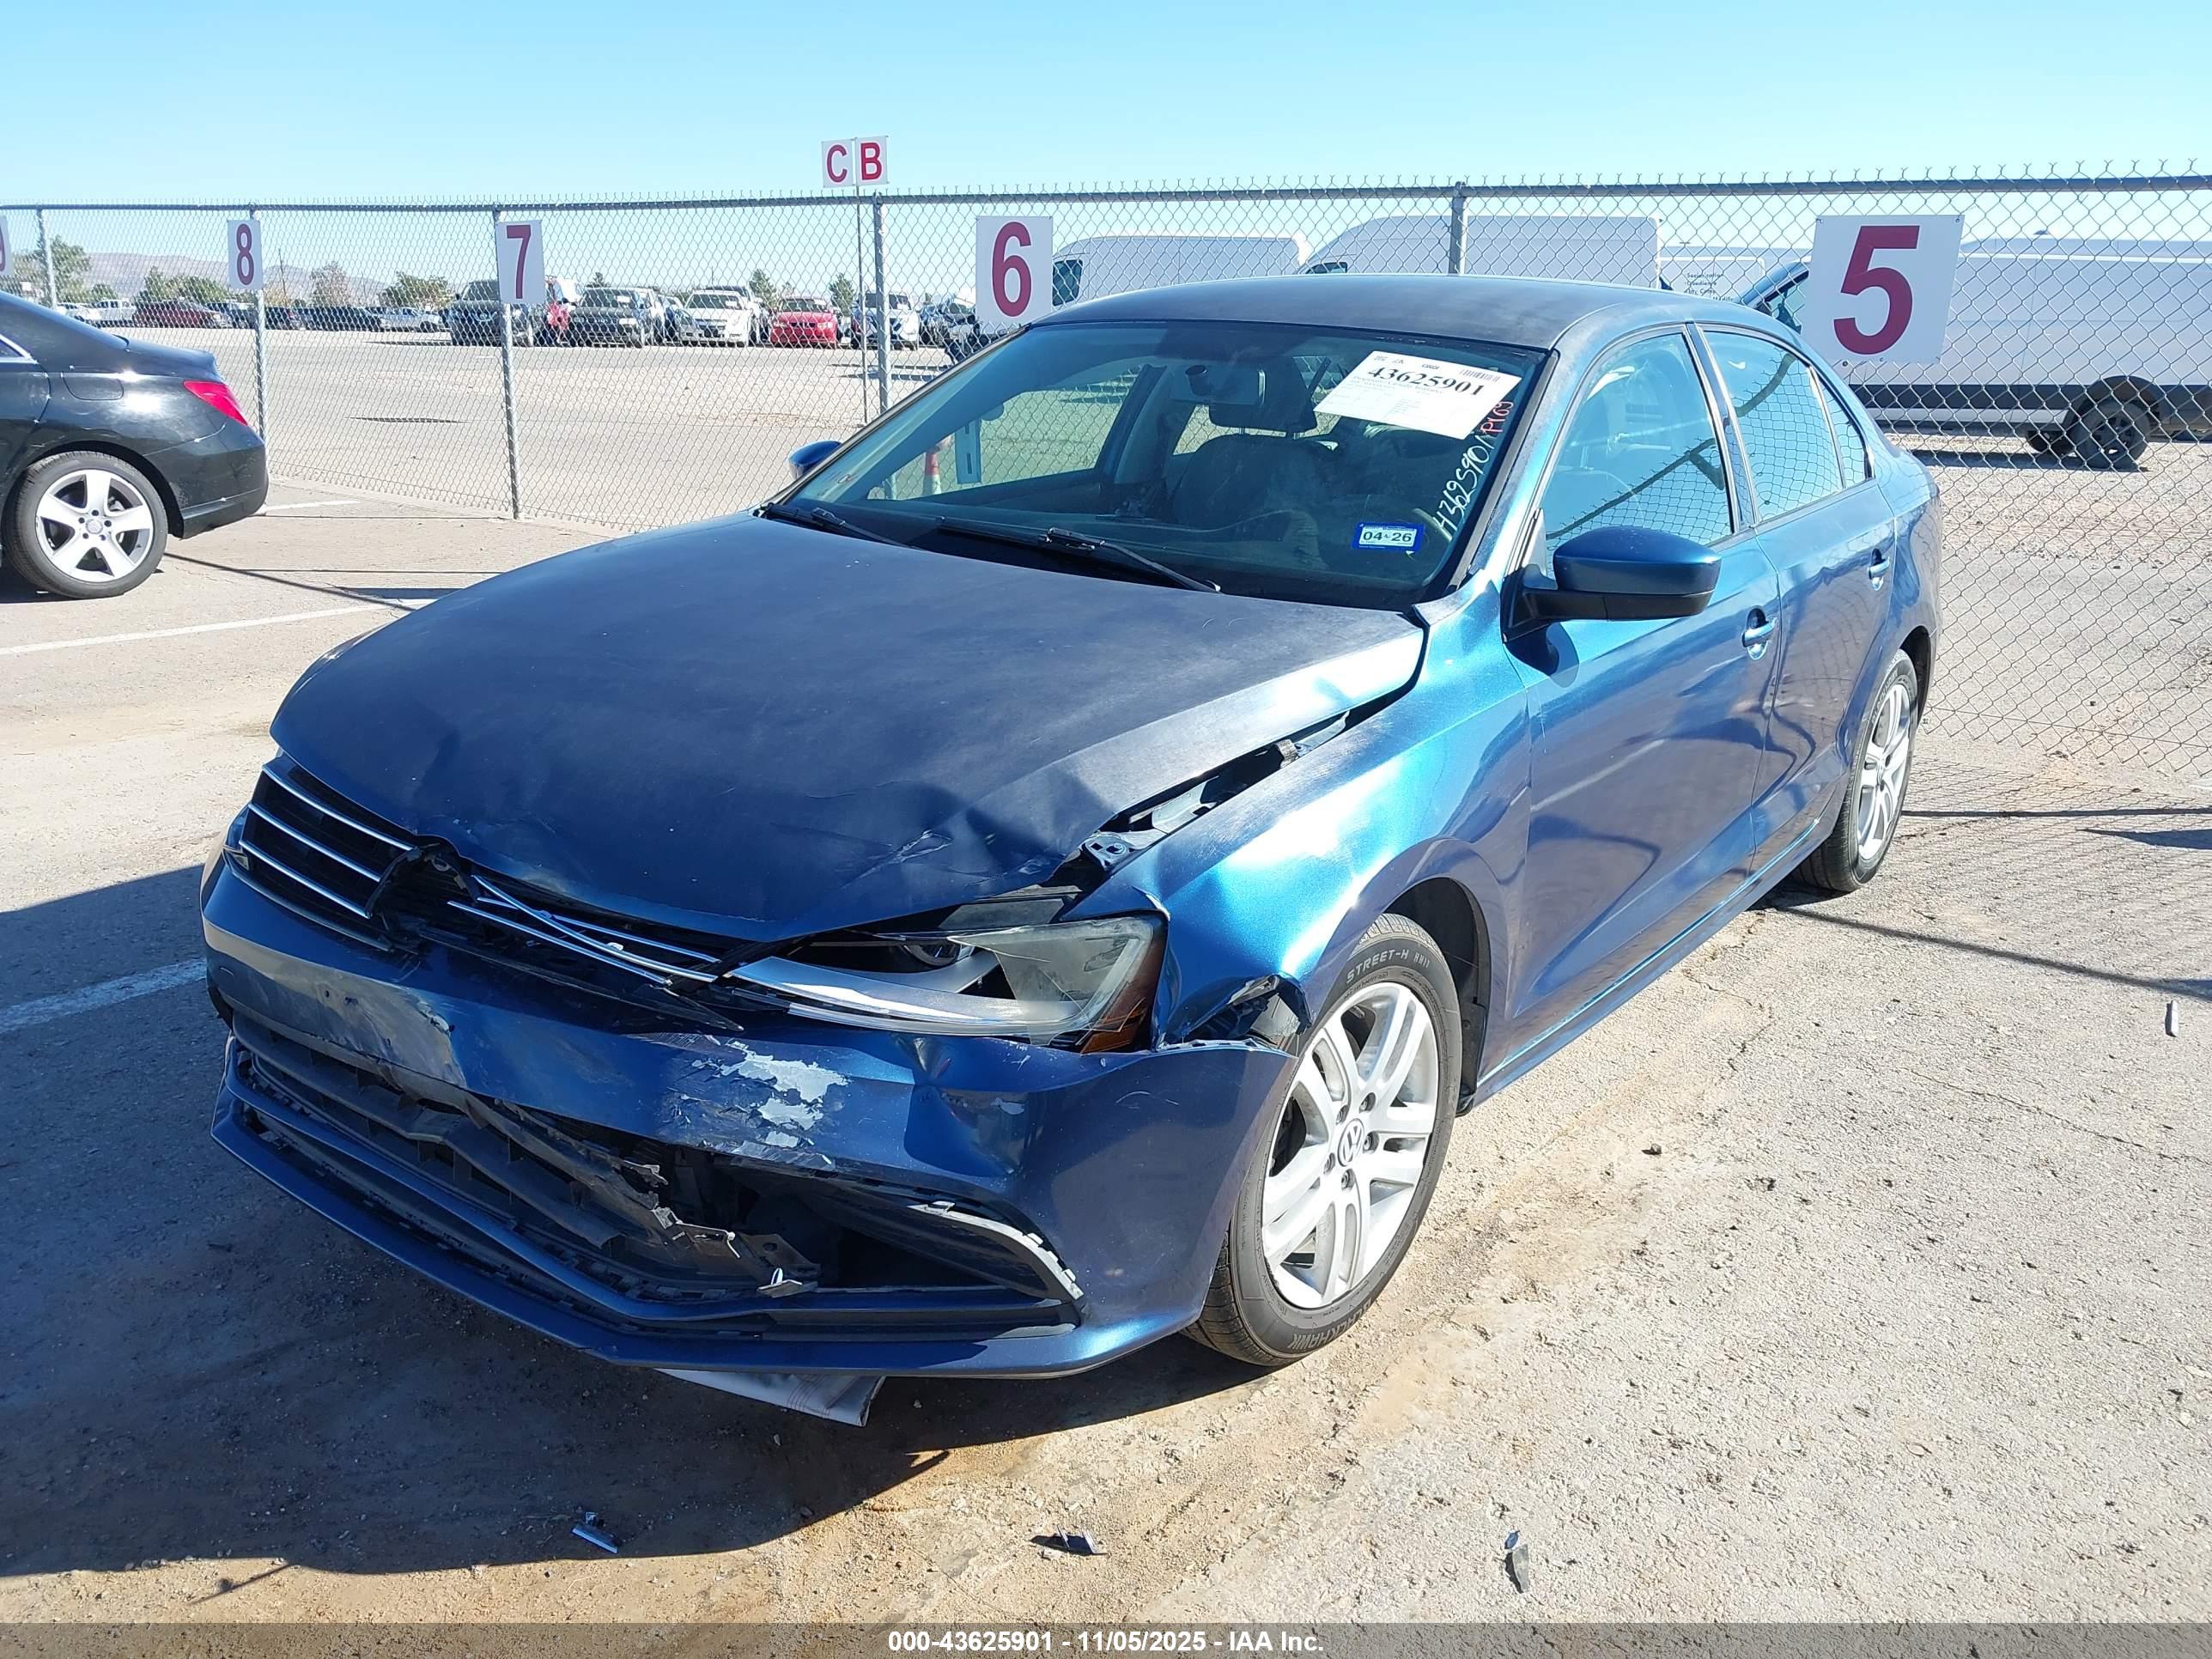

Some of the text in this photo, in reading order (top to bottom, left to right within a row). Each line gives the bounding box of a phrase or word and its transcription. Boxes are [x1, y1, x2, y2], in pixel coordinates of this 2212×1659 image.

[826, 144, 848, 183] C
[860, 142, 883, 181] B
[235, 222, 255, 287] 8
[506, 224, 532, 300] 7
[992, 221, 1032, 318] 6
[1832, 225, 1920, 355] 5
[1368, 367, 1484, 396] 43625901
[1363, 531, 1413, 542] 04 26
[1346, 949, 1409, 984] STREET-H
[1287, 1297, 1372, 1350] BLACKHAWK
